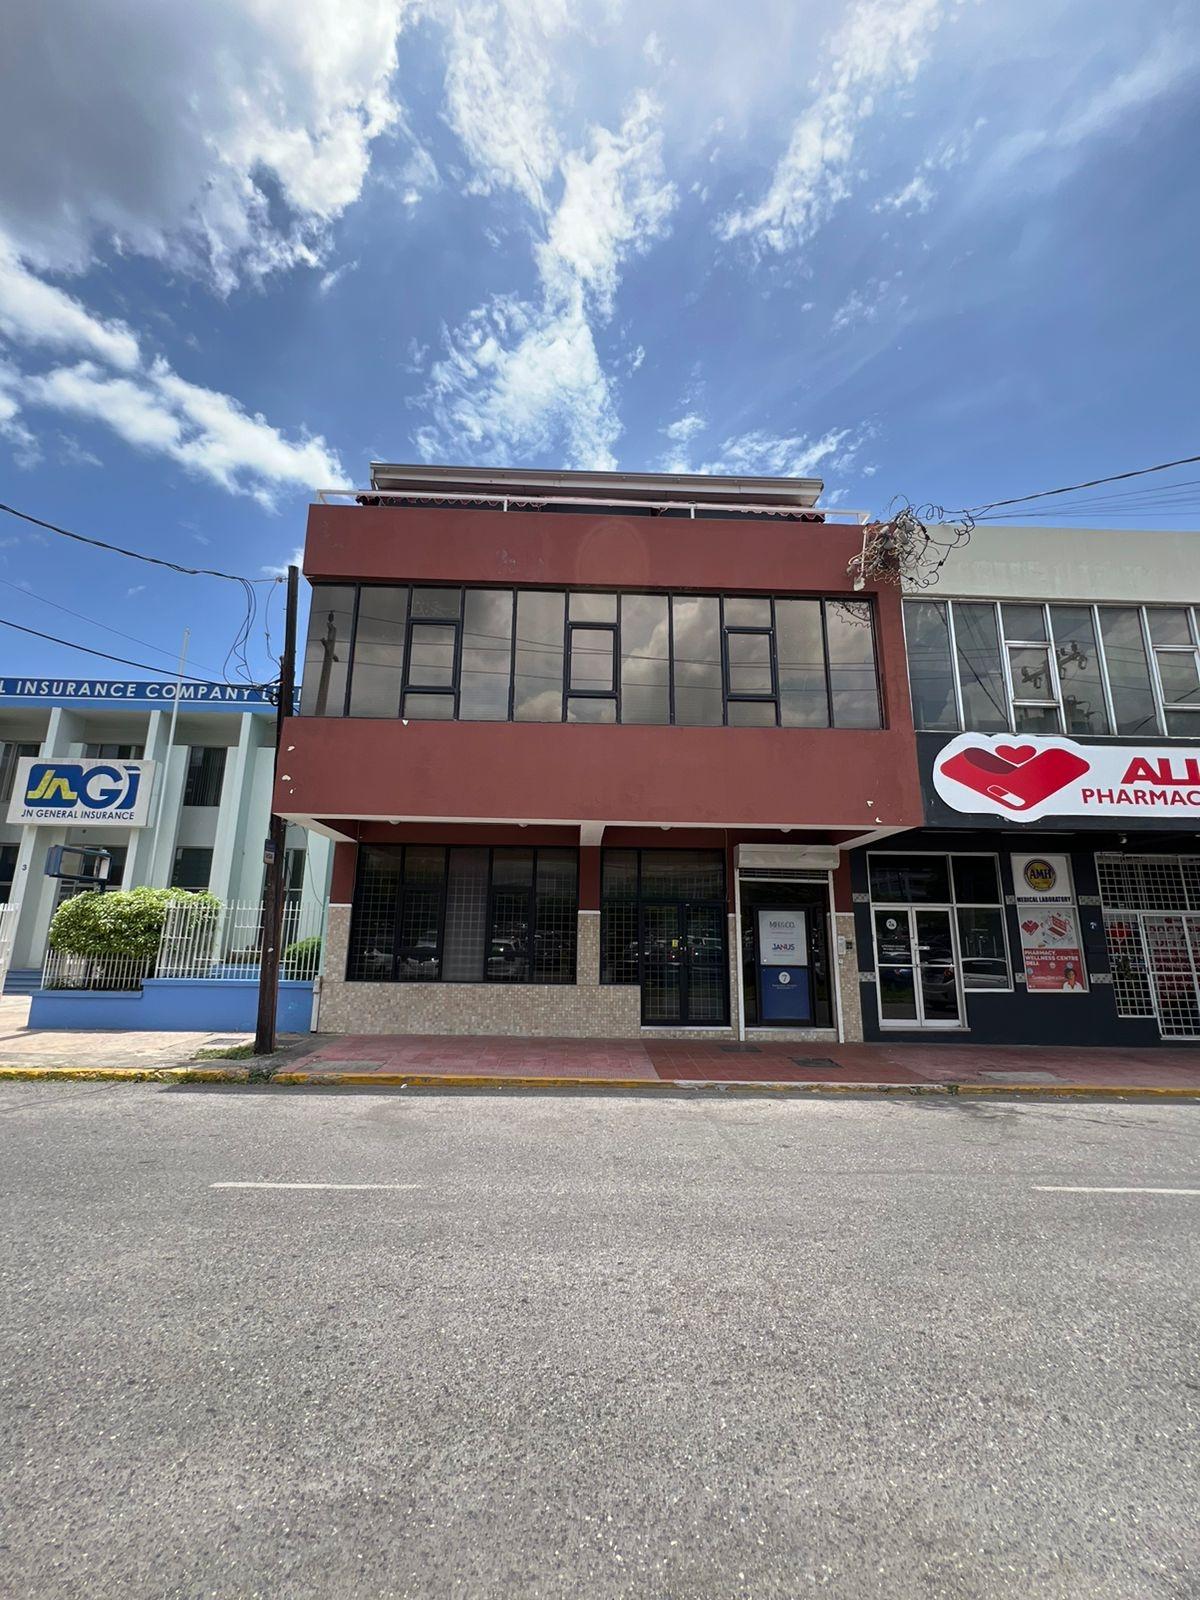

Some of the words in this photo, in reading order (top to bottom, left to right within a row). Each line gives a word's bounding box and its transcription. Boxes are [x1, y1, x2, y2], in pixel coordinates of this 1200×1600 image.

[16, 681, 137, 697] INSURANCE
[145, 684, 251, 700] COMPANY
[21, 809, 34, 818] JN
[36, 809, 79, 819] GENERAL
[80, 811, 135, 820] INSURANCE
[1029, 869, 1052, 880] AMH
[772, 943, 795, 951] JANUS
